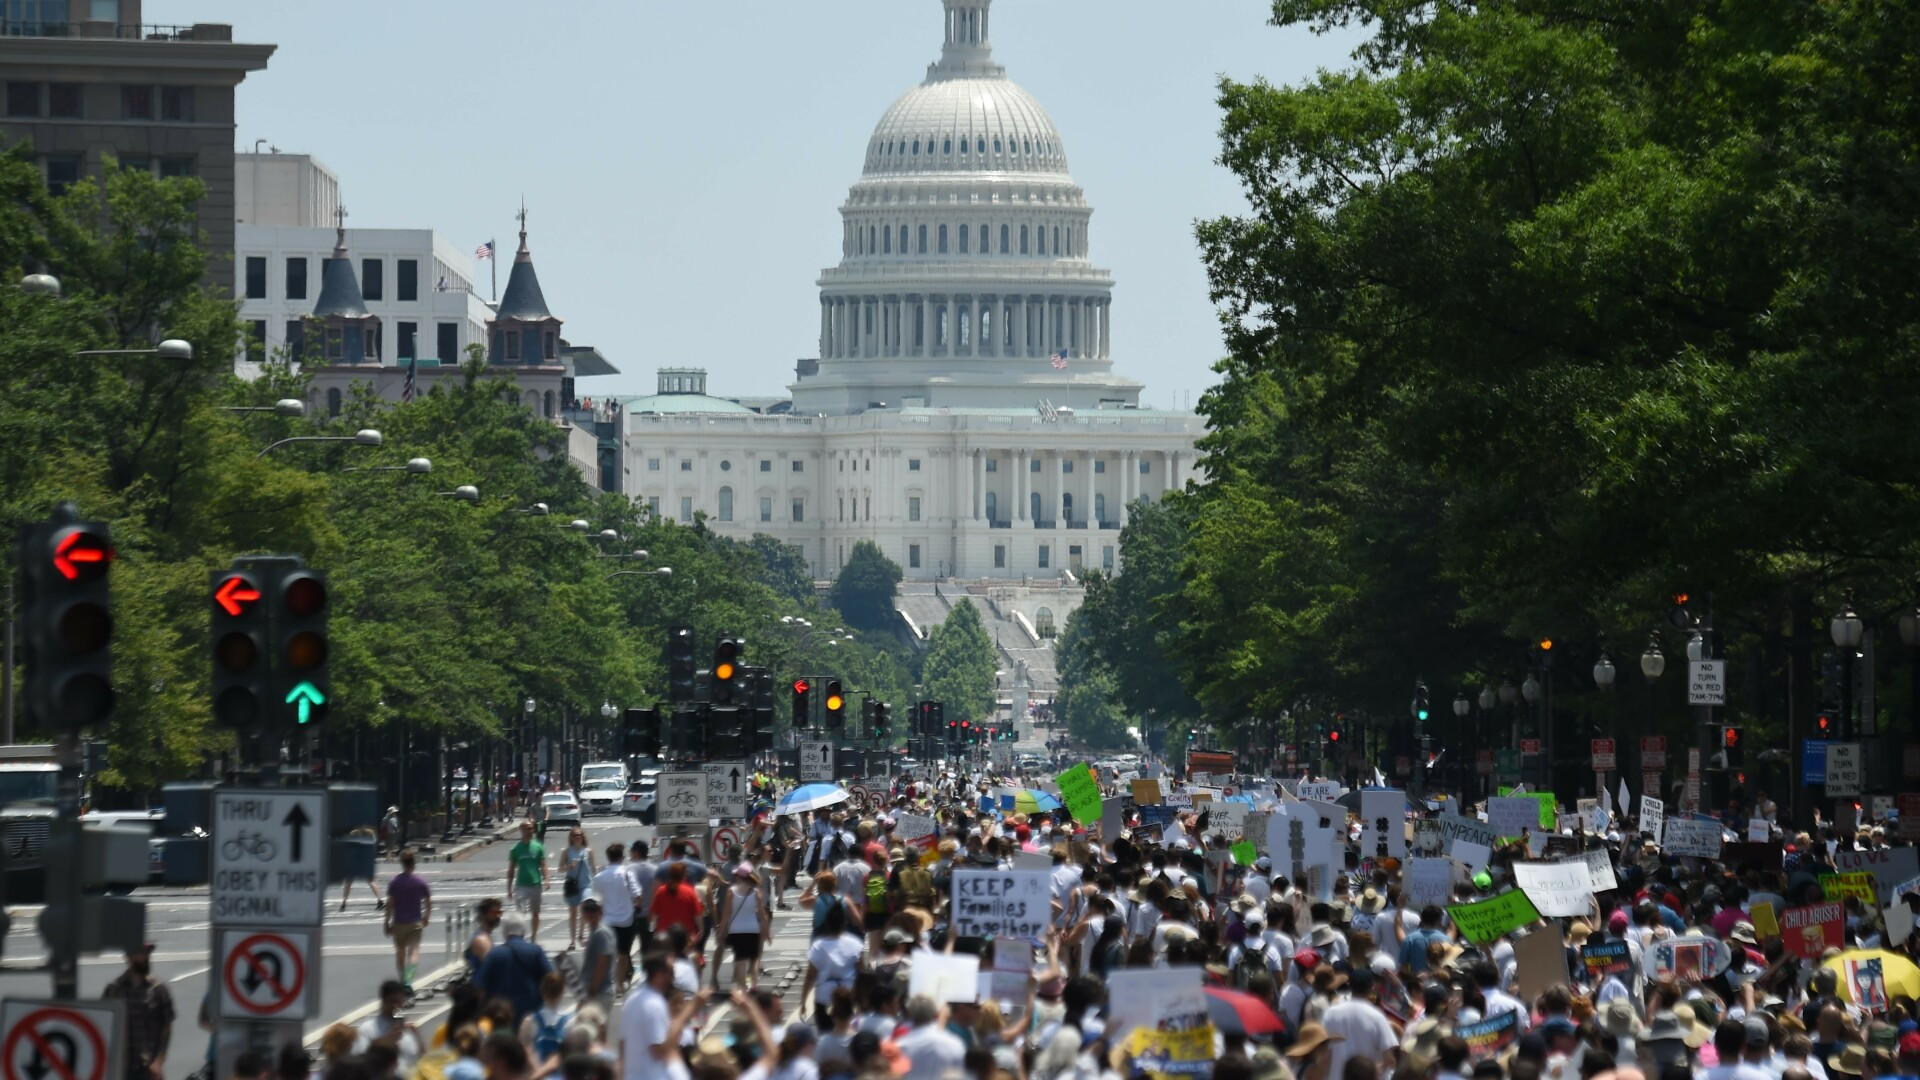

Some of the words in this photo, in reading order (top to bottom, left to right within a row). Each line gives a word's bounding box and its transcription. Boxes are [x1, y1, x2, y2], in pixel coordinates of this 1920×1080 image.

[1701, 664, 1713, 672] NO
[1697, 674, 1717, 682] TURN
[803, 743, 818, 751] THRU
[1836, 748, 1849, 757] NO
[1833, 760, 1853, 769] TURN
[704, 766, 725, 776] THRU
[1828, 772, 1839, 781] ON
[1842, 772, 1857, 781] RED
[667, 778, 698, 786] TURNING
[1301, 786, 1313, 795] WE
[1315, 786, 1330, 795] ARE
[708, 795, 724, 805] BEY
[727, 795, 744, 805] THIS
[1644, 799, 1661, 810] CHILD
[220, 800, 273, 821] THRU
[710, 806, 730, 816] GNAL
[1203, 805, 1232, 820] NEVER
[1642, 807, 1662, 819] ABUSE
[1646, 820, 1657, 830] NOT
[1441, 820, 1498, 848] IMPEACH
[1842, 852, 1888, 869] LOVE
[1591, 864, 1611, 875] NOT
[216, 870, 268, 892] OBEY
[276, 870, 317, 892] THIS
[959, 878, 1015, 898] KEEP
[216, 896, 284, 918] SIGNAL
[958, 898, 1026, 919] Families
[1452, 907, 1497, 921] History
[1502, 901, 1513, 910] is
[1464, 912, 1515, 932] watching
[1785, 910, 1808, 929] CHILD
[1808, 904, 1841, 924] ABUSER
[957, 918, 1042, 937] Together
